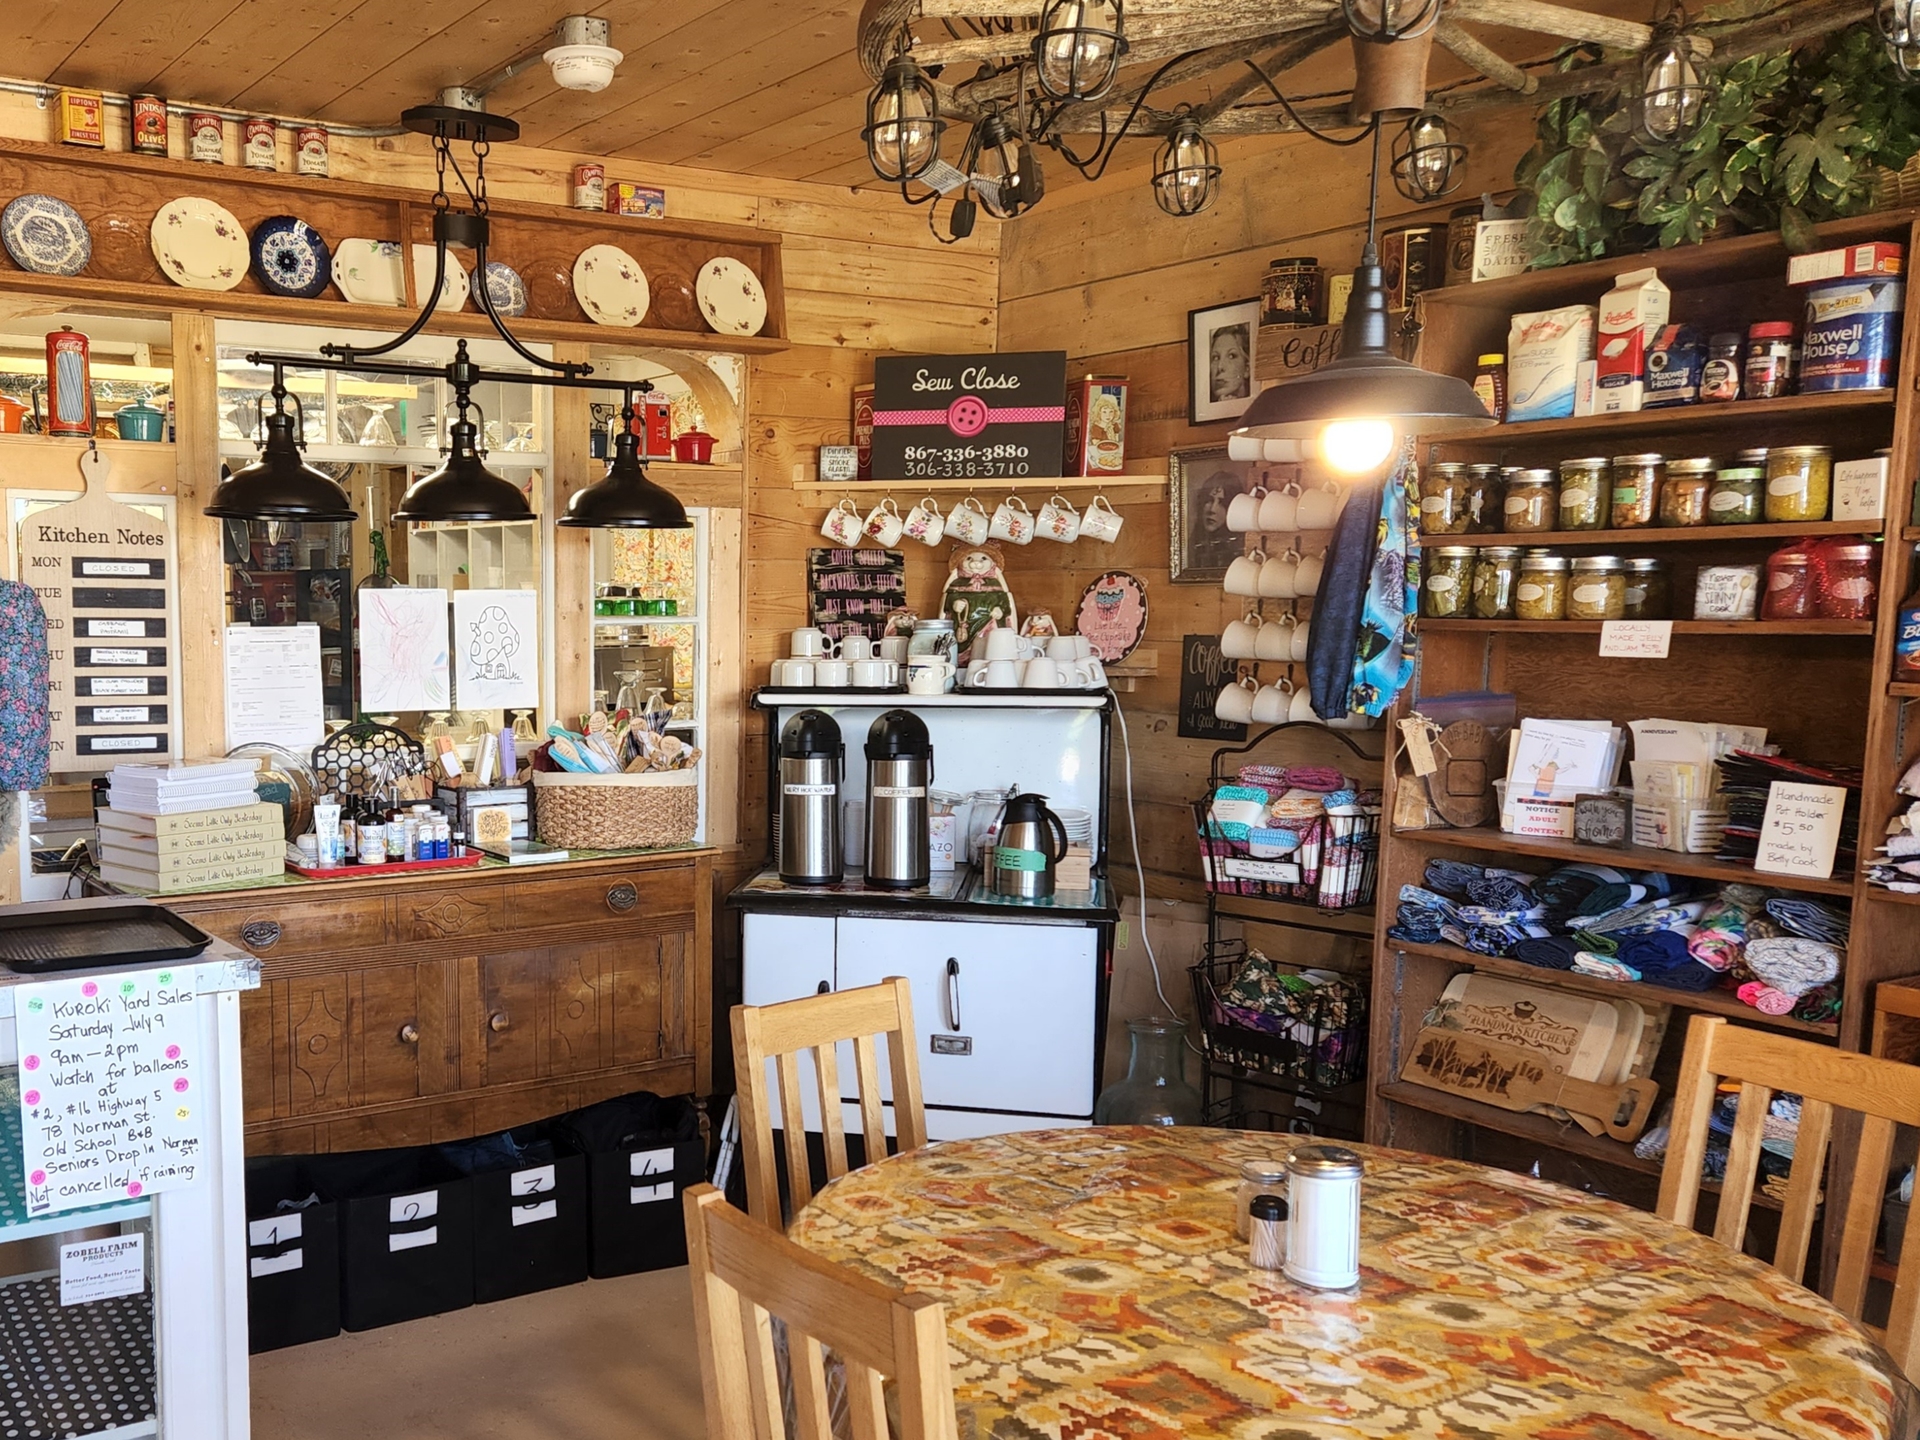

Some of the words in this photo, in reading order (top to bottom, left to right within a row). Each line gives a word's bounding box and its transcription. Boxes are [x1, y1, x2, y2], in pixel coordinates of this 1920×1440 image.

[70, 97, 98, 107] LIPTON'S
[137, 132, 166, 144] OLIVES
[1282, 328, 1341, 369] Coff
[912, 368, 954, 392] Sew
[960, 366, 1021, 390] Close
[1651, 367, 1690, 380] Maxwell
[1651, 378, 1681, 389] House
[904, 444, 1029, 462] 867-336-3880
[904, 462, 1029, 477] 306-338-3710
[38, 526, 110, 544] Kitchen
[117, 528, 164, 546] Notes
[31, 557, 62, 567] MON
[831, 549, 854, 566] COFFEE
[858, 549, 886, 566] SPELLED
[35, 587, 62, 598] TUE
[825, 598, 840, 614] JUST
[845, 598, 865, 616] KNOW
[869, 598, 885, 614] THAT
[47, 619, 64, 629] ED
[1613, 624, 1651, 632] LOCALLY
[1610, 634, 1634, 642] MADE
[1639, 634, 1664, 642] JELLY
[48, 681, 62, 691] RI
[48, 711, 62, 721] AT
[1776, 787, 1835, 805] Handmade
[1526, 806, 1560, 814] NOTICE
[1776, 804, 1791, 815] Pot
[1795, 807, 1829, 819] Holder
[184, 818, 204, 829] Seems
[220, 814, 233, 826] Only
[234, 811, 263, 822] Yesterday
[185, 836, 205, 848] Seems
[221, 833, 234, 844] Only
[236, 829, 263, 841] Yesterday
[1521, 826, 1565, 835] CONTENT
[187, 854, 207, 865] Seems
[223, 851, 235, 862] Only
[237, 847, 265, 858] Yesterday
[930, 843, 953, 852] AZO
[1767, 842, 1796, 851] made
[1800, 843, 1813, 856] by
[1792, 855, 1818, 869] Cook
[186, 873, 205, 884] Seems
[221, 869, 234, 880] Only
[235, 865, 263, 876] Yesterday
[119, 990, 150, 1012] Yard
[157, 988, 193, 1006] Sales
[49, 1020, 113, 1041] Saturday
[122, 1014, 151, 1033] July
[154, 1014, 165, 1027] 9
[1522, 1026, 1570, 1046] KITCHEN
[50, 1069, 94, 1087] Watch
[105, 1063, 127, 1081] for
[133, 1059, 189, 1077] balloons
[98, 1082, 118, 1097] at
[66, 1101, 91, 1116] #16
[98, 1095, 148, 1116] Highway
[153, 1089, 162, 1101] 5
[41, 1125, 63, 1141] 78
[73, 1118, 129, 1136] Norman
[43, 1140, 67, 1157] Old
[74, 1133, 117, 1153] School
[45, 1155, 99, 1174] Seniors
[105, 1149, 141, 1167] Drop
[144, 1143, 155, 1155] In
[162, 1137, 199, 1150] Norman
[29, 1185, 53, 1204] Not
[59, 1169, 130, 1196] cancelled
[139, 1166, 150, 1182] if
[154, 1163, 195, 1180] raining
[642, 1158, 658, 1196] 4
[523, 1177, 543, 1210] 3
[65, 1246, 106, 1259] ZOBELL
[108, 1240, 138, 1252] FARM
[82, 1250, 124, 1262] PRODUCTS
